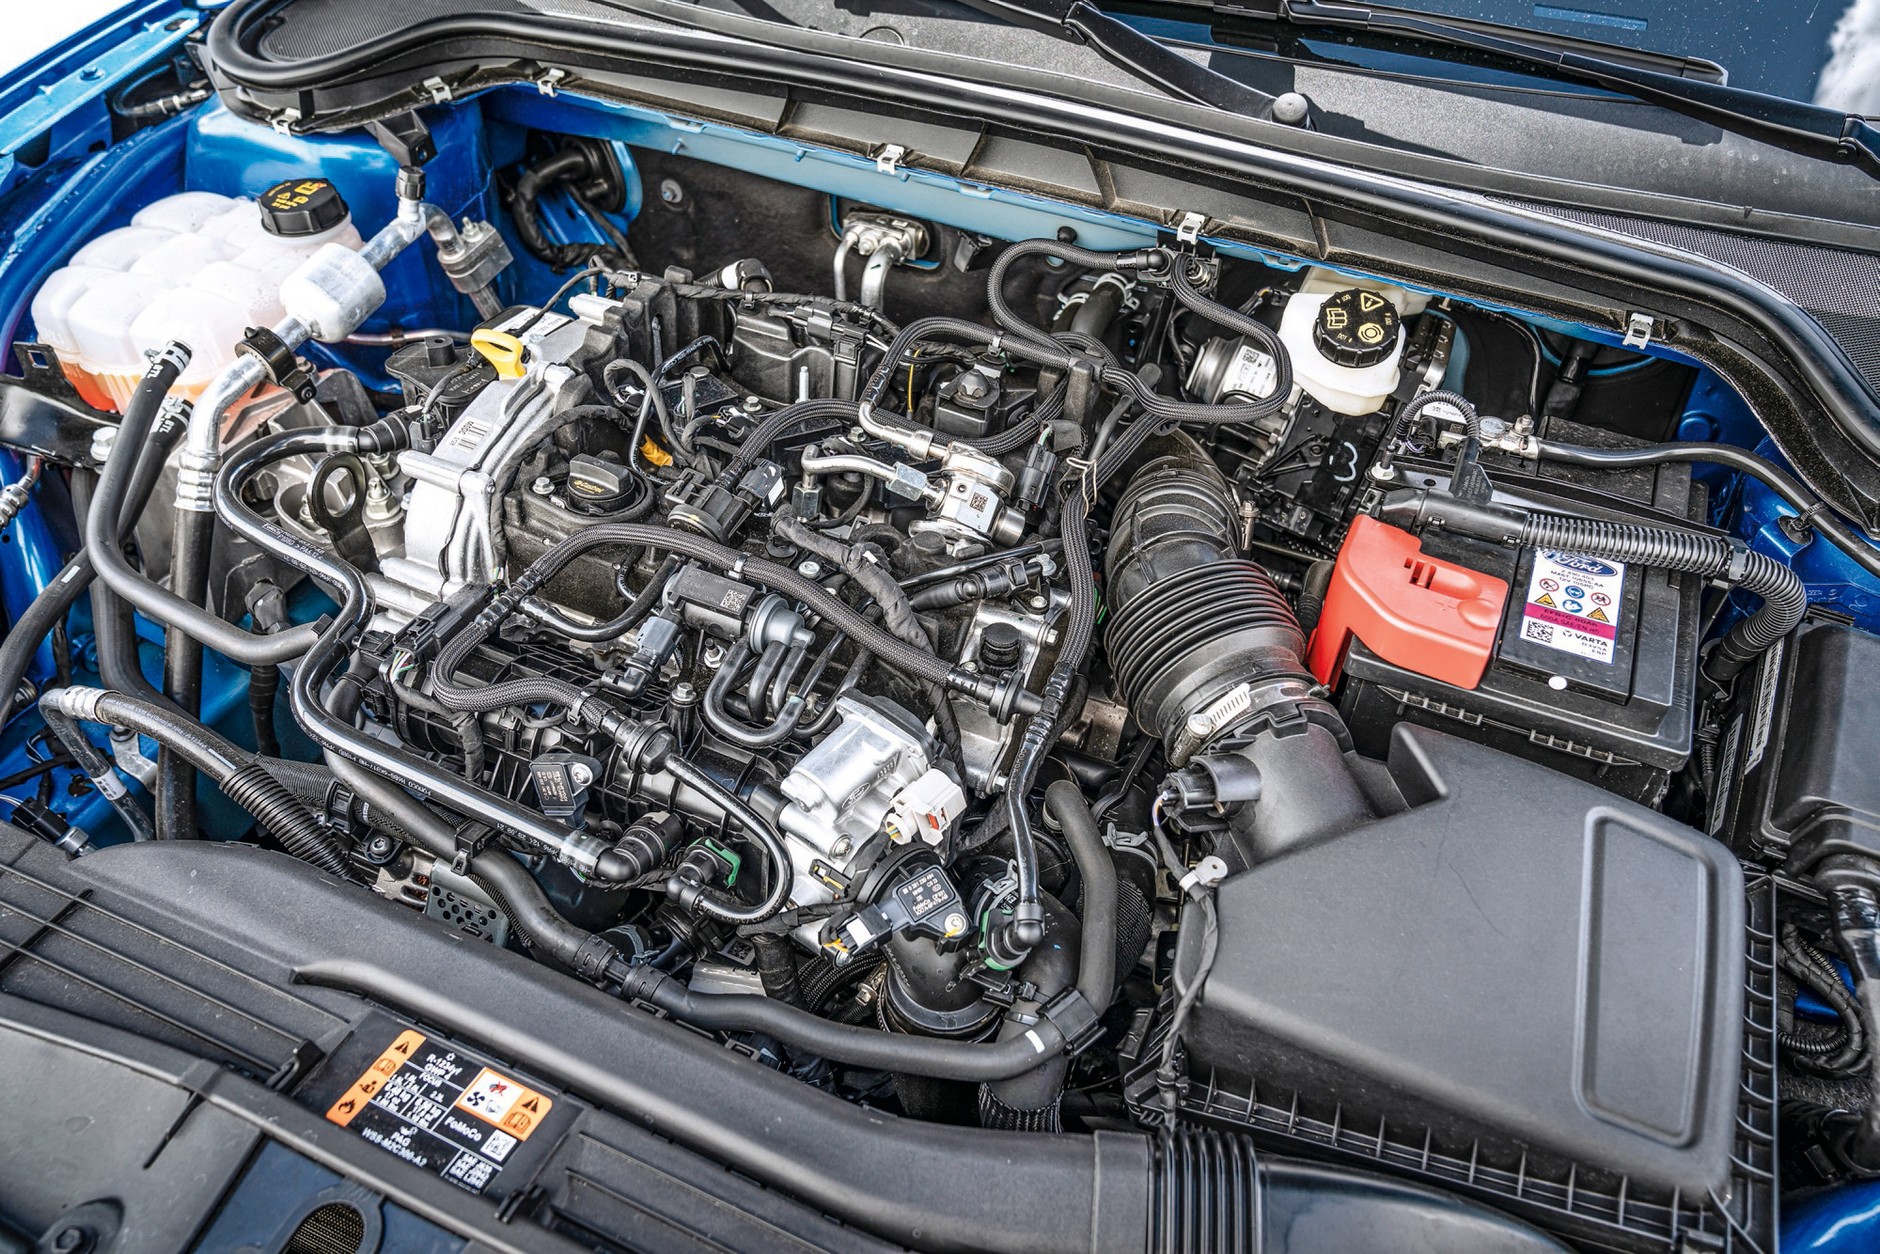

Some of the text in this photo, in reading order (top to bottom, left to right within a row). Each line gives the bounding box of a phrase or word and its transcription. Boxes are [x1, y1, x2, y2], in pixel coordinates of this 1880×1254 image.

[1575, 633, 1608, 646] VARTA
[424, 1064, 447, 1078] GWP
[426, 1054, 463, 1075] R-1234yf
[419, 1073, 442, 1087] FOCUS
[444, 1116, 482, 1142] FoMoCo
[391, 1132, 411, 1147] PAG
